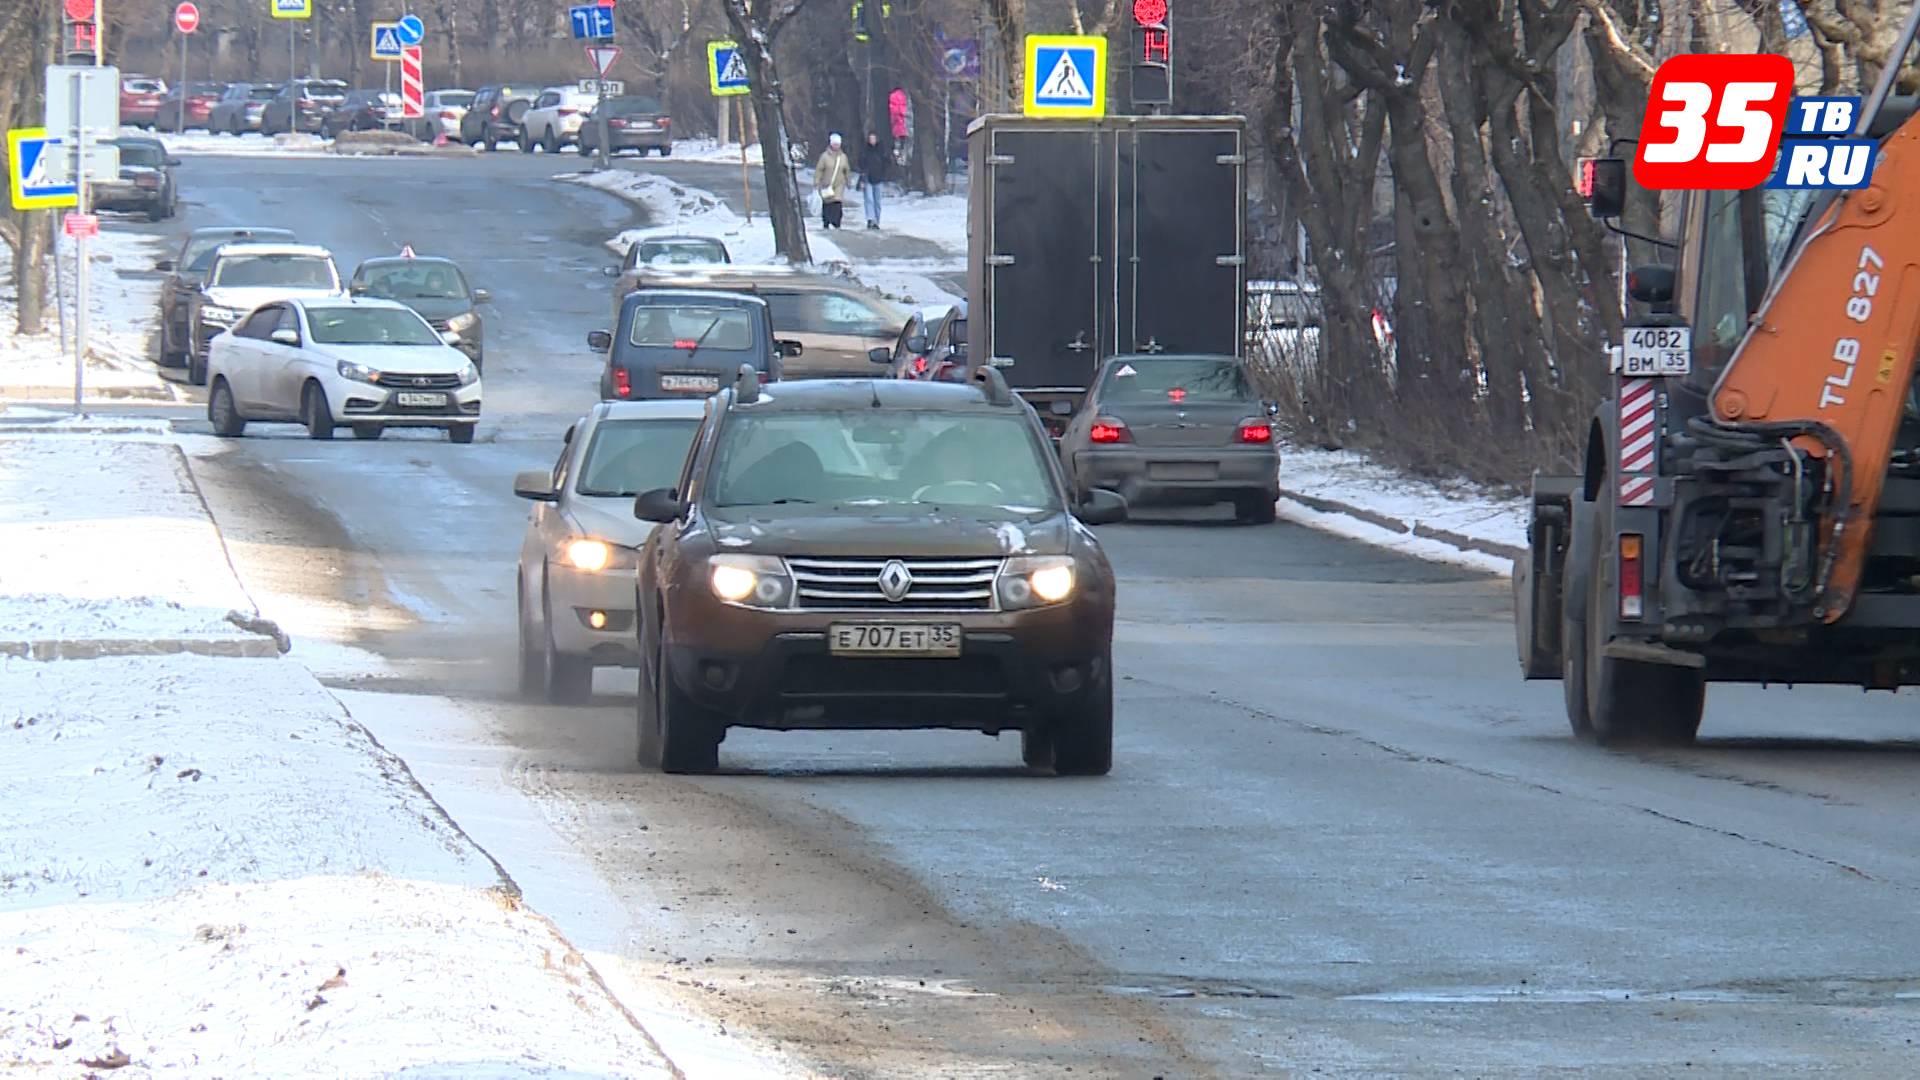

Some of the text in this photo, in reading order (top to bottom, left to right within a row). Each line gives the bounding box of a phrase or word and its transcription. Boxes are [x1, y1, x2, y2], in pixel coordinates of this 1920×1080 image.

[583, 81, 619, 93] Соп
[1819, 246, 1885, 409] TLB 827
[1631, 330, 1682, 349] 4082
[1629, 352, 1686, 372] ВМ 35
[839, 626, 952, 648] Е707ЕТ 35
